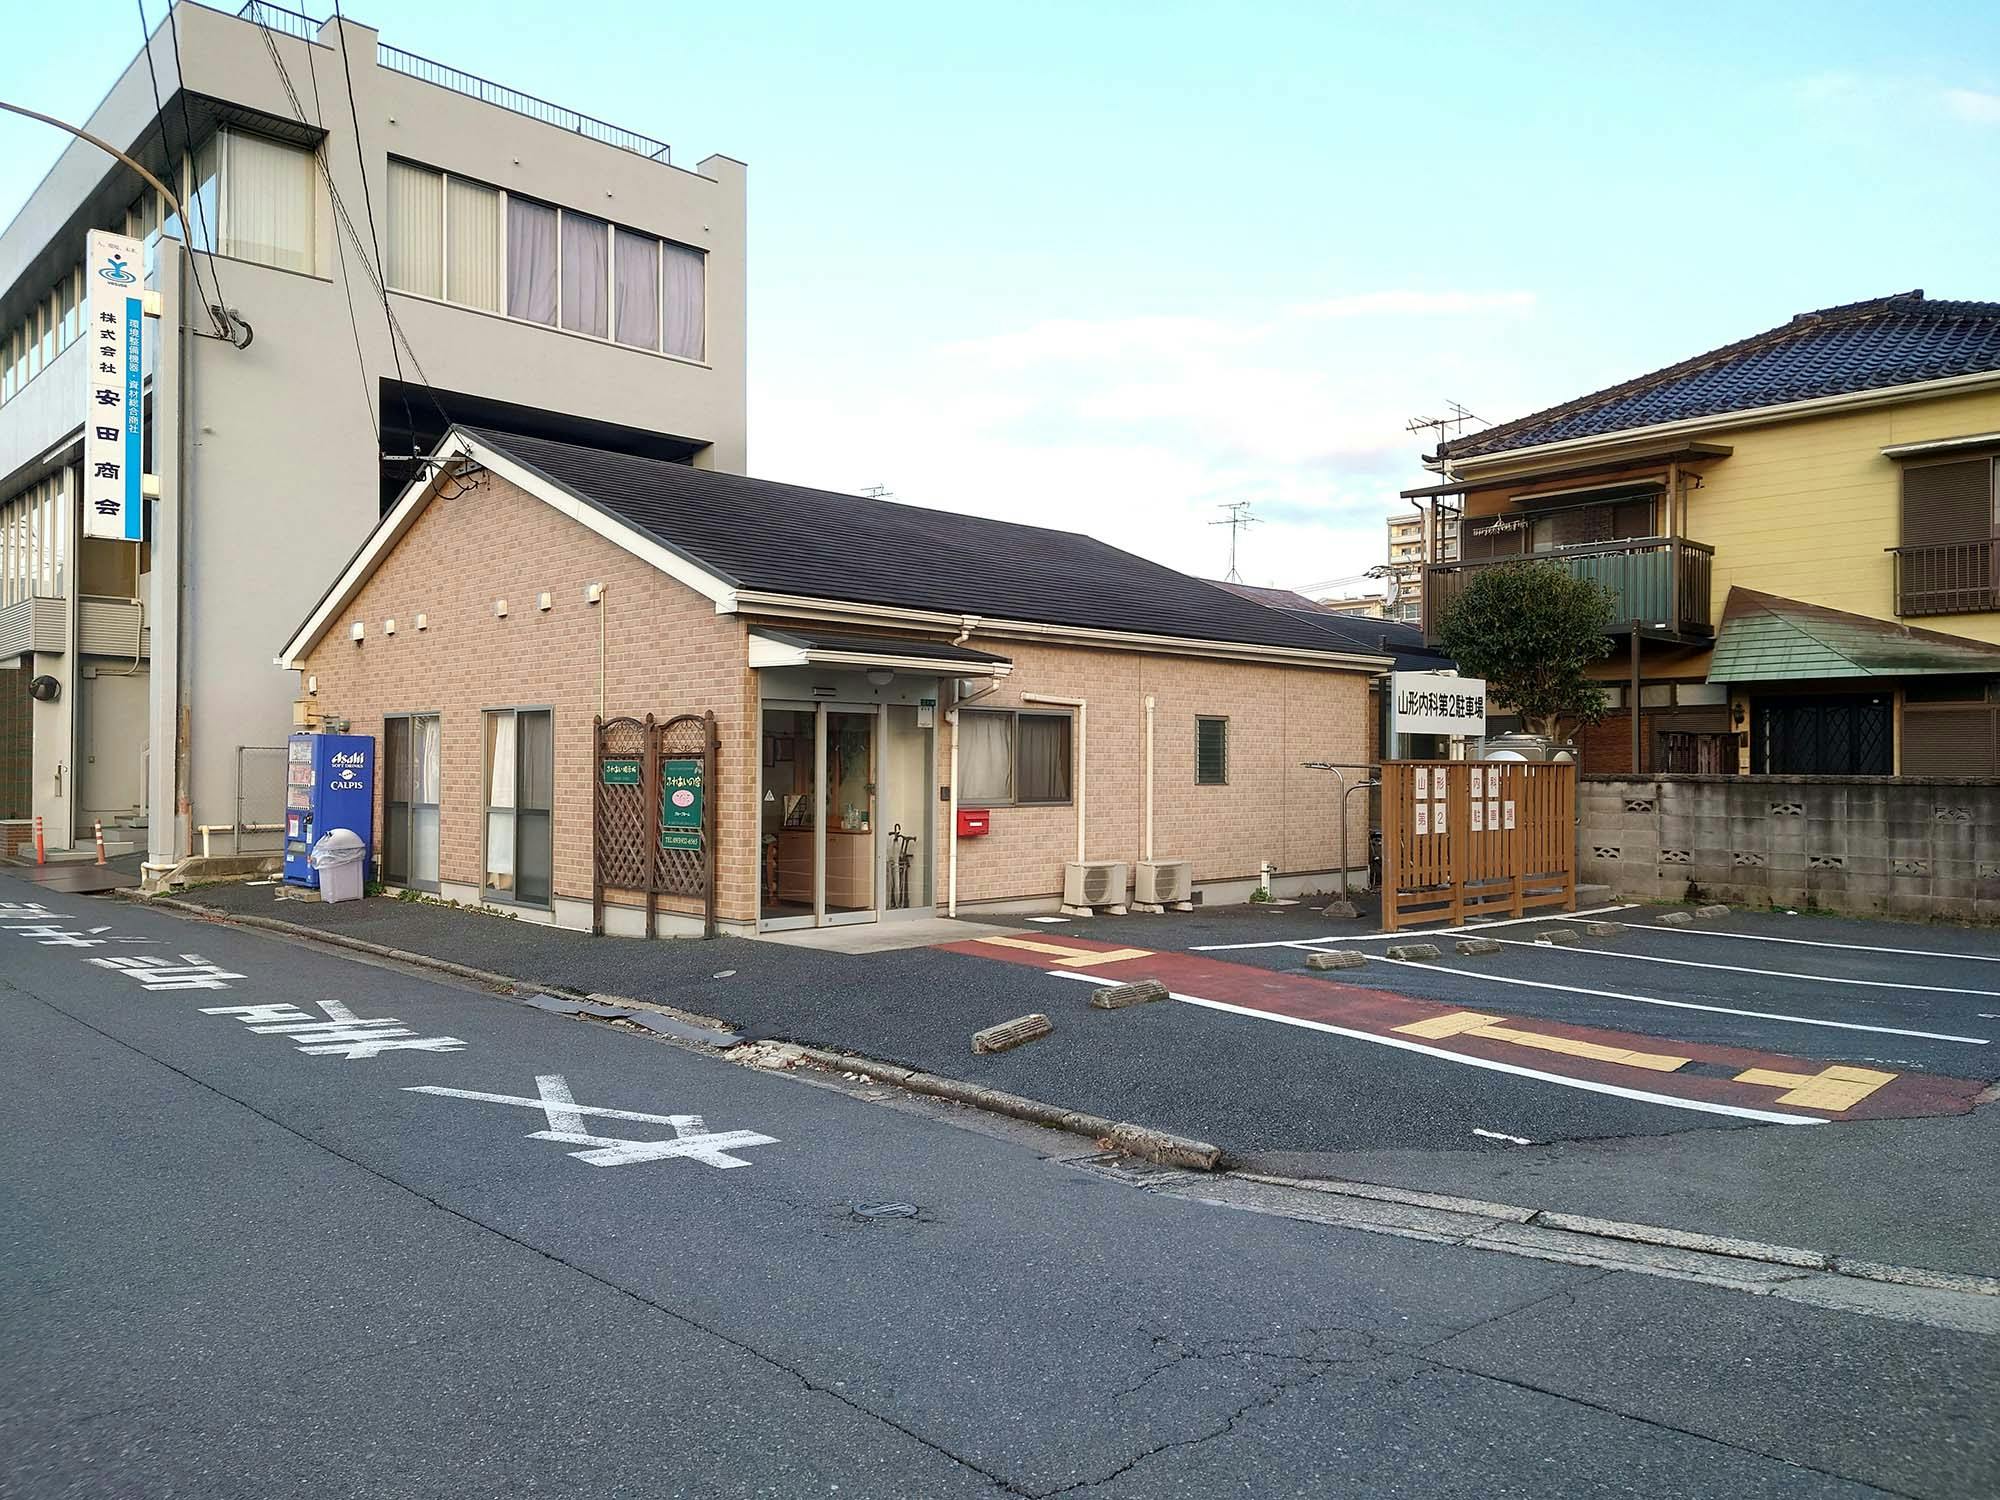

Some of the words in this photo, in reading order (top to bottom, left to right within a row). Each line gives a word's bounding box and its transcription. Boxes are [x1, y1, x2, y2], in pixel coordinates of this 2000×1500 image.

[1397, 690, 1484, 720] 山形内科第2駐車場
[331, 752, 364, 764] Asahi
[330, 781, 363, 791] CALPIS
